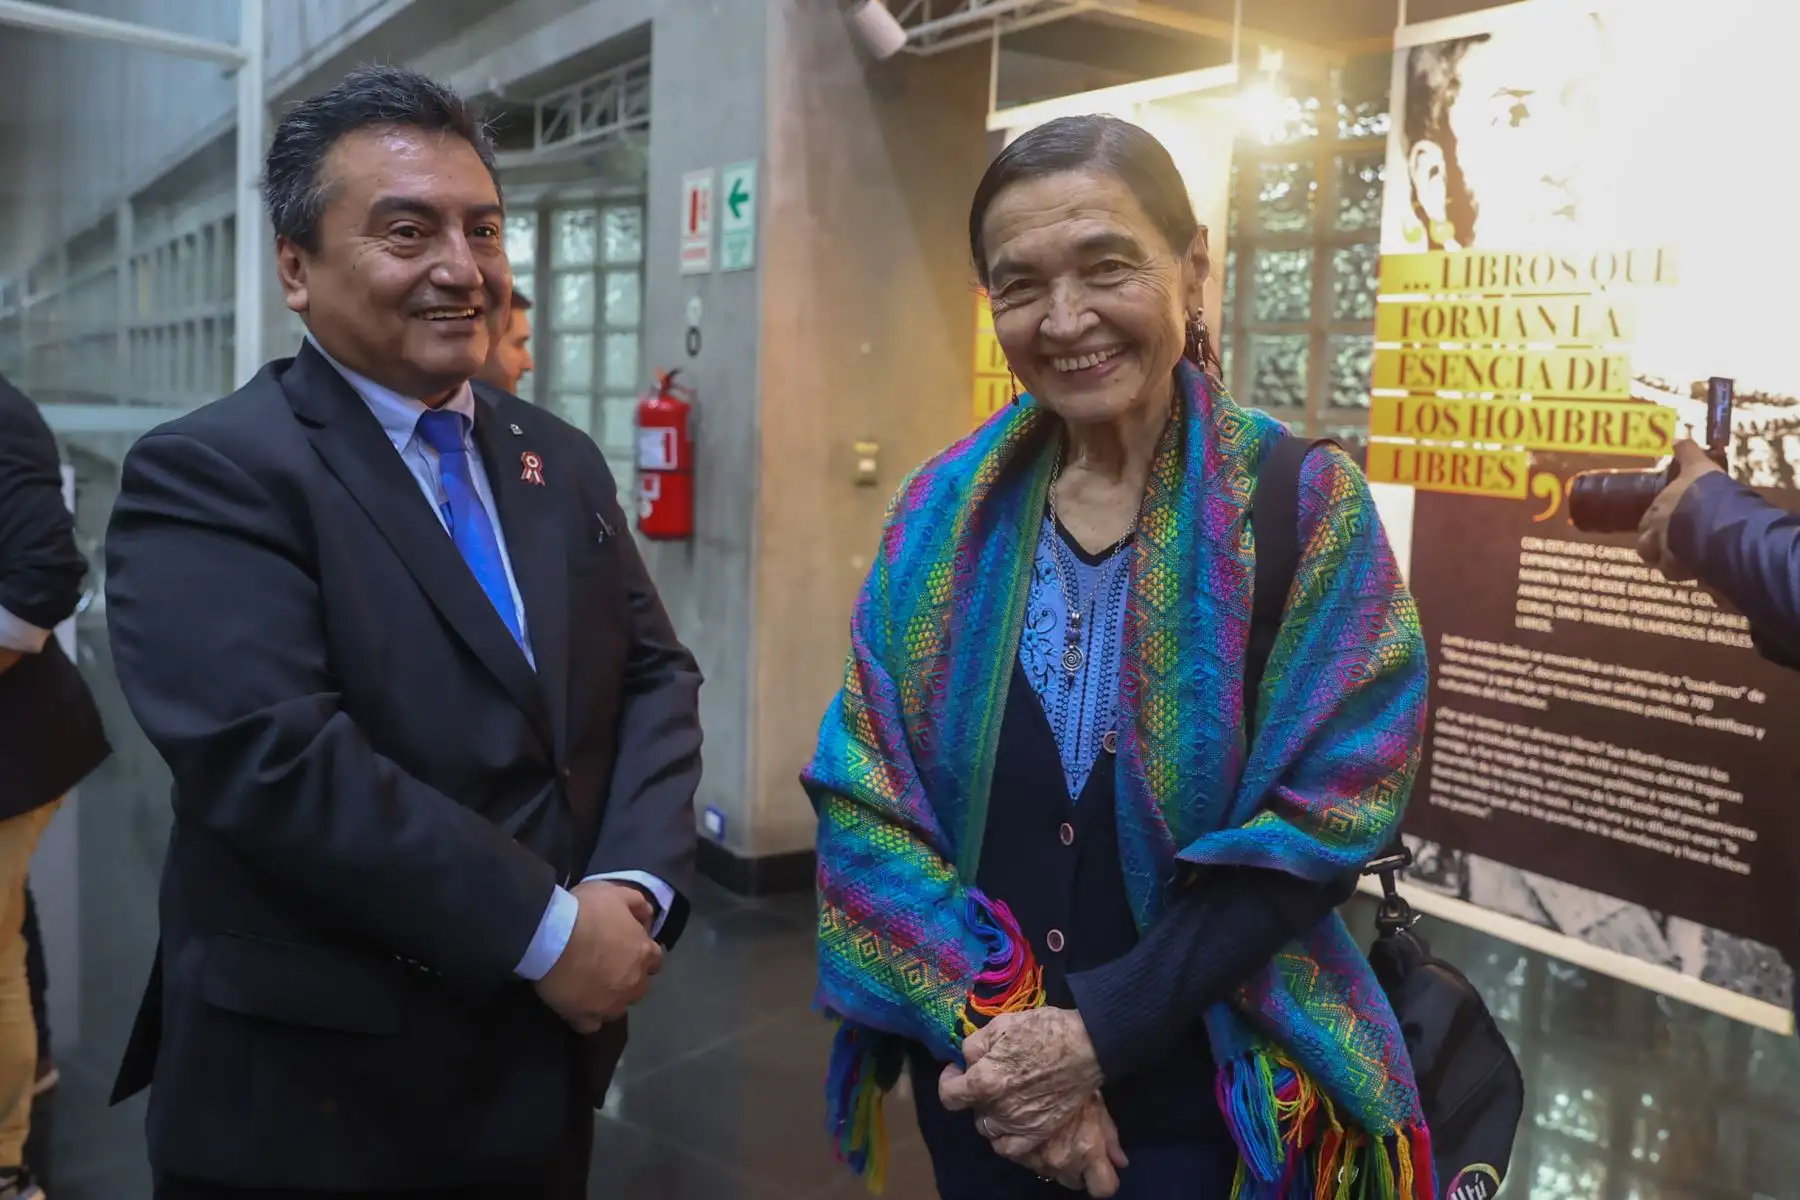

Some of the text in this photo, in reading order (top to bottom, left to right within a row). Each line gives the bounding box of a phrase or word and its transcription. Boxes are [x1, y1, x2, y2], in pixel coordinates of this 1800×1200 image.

[1440, 253, 1579, 290] LIBROS
[1591, 246, 1679, 292] QUE
[1400, 302, 1622, 340] FORMAN LA
[1396, 353, 1623, 394] ESENCIA DE
[1393, 400, 1671, 451] LOS HOMBRES
[1391, 447, 1518, 491] LIBRES
